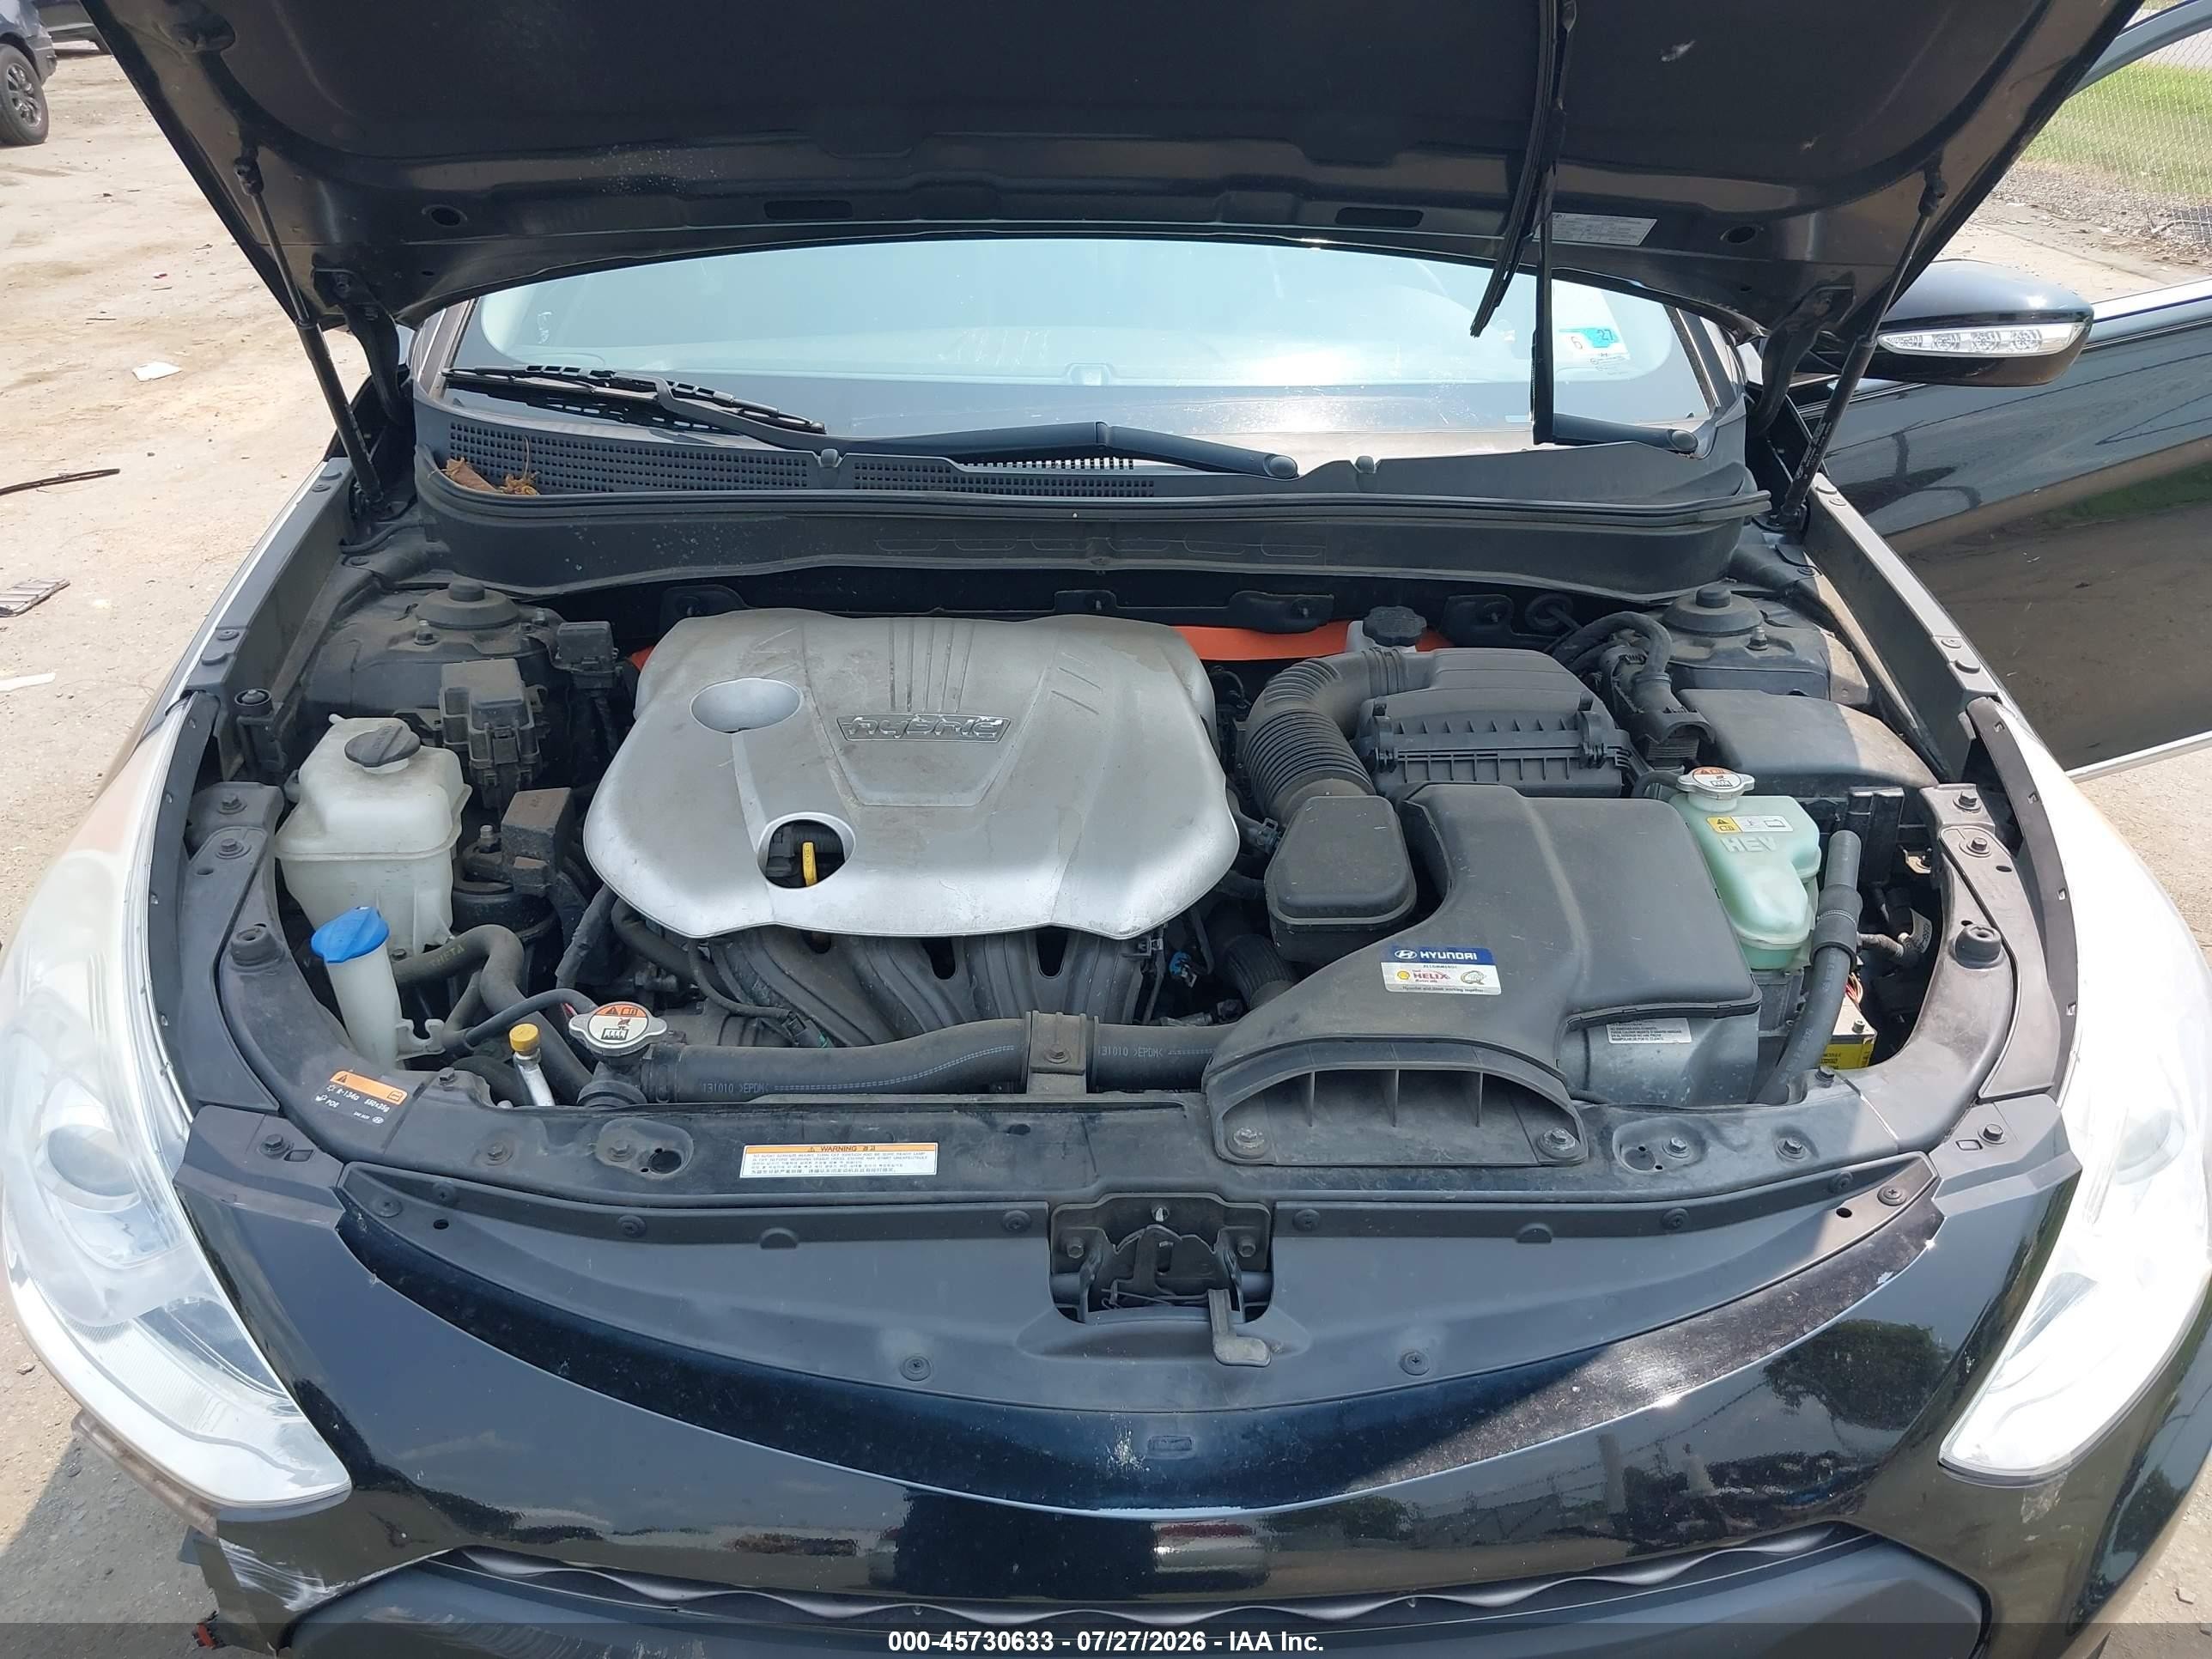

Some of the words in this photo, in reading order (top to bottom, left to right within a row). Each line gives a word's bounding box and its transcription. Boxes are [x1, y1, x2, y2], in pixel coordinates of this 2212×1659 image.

[1596, 329, 1613, 341] 27
[1571, 336, 1583, 349] 6
[1720, 836, 1778, 853] HEV
[1419, 951, 1478, 960] HYUNDAI
